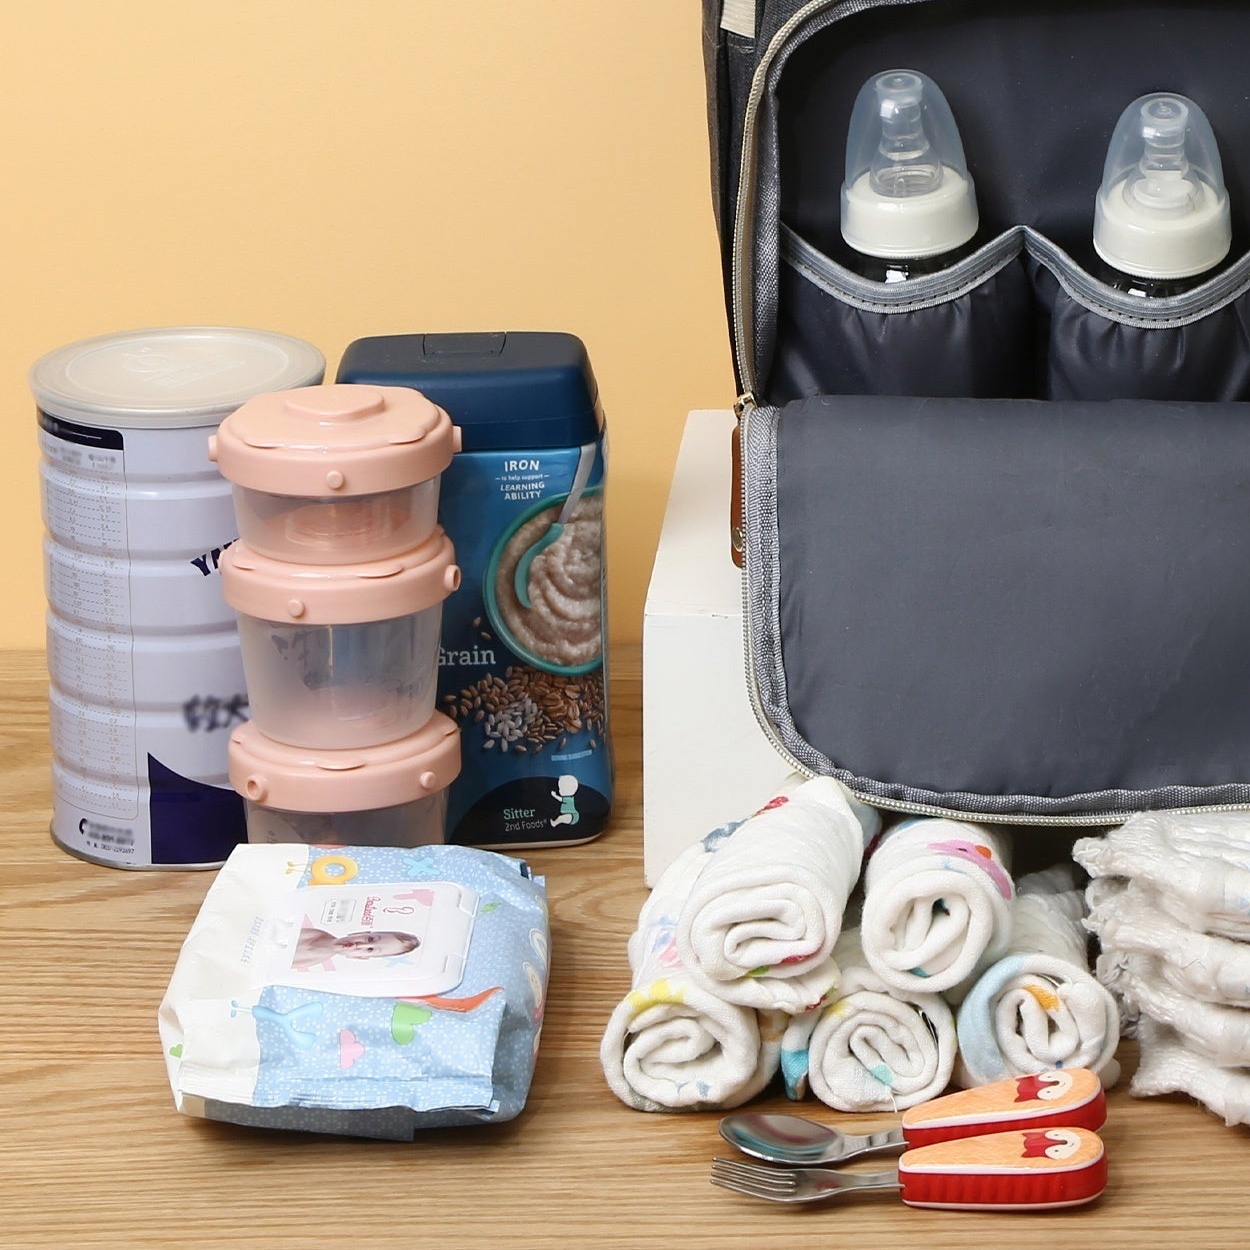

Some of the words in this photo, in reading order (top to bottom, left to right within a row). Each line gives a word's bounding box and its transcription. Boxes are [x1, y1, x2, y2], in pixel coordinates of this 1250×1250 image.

[504, 459, 540, 472] IRON
[508, 474, 521, 482] help
[521, 473, 543, 481] support
[500, 481, 545, 492] LEARNING
[504, 490, 541, 500] ABILITY
[439, 645, 497, 666] Grain
[503, 808, 536, 820] Sitter
[505, 822, 520, 832] 2nd
